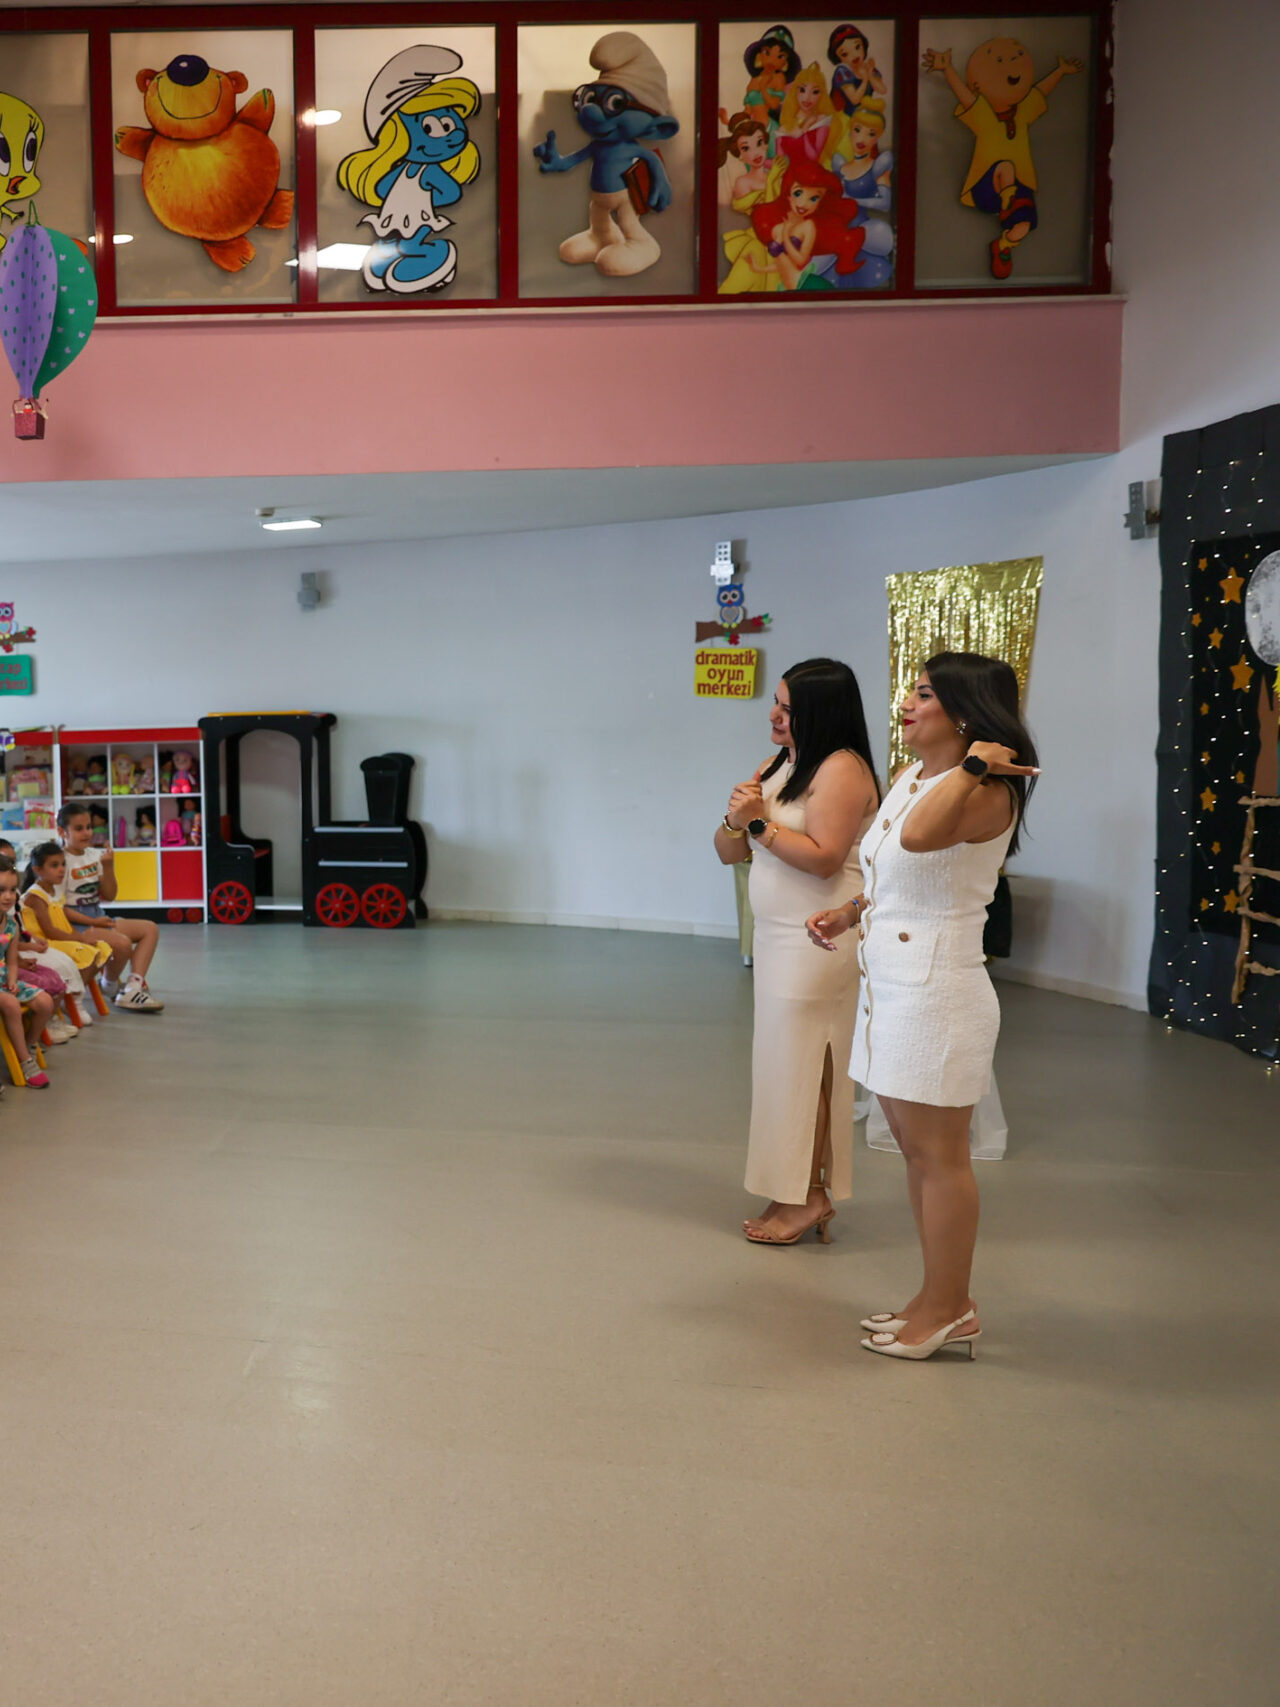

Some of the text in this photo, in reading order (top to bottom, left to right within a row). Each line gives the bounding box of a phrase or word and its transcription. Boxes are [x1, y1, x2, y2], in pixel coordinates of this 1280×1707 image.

[695, 651, 755, 665] dramatik
[707, 668, 744, 683] oyun
[697, 681, 751, 696] merkezi
